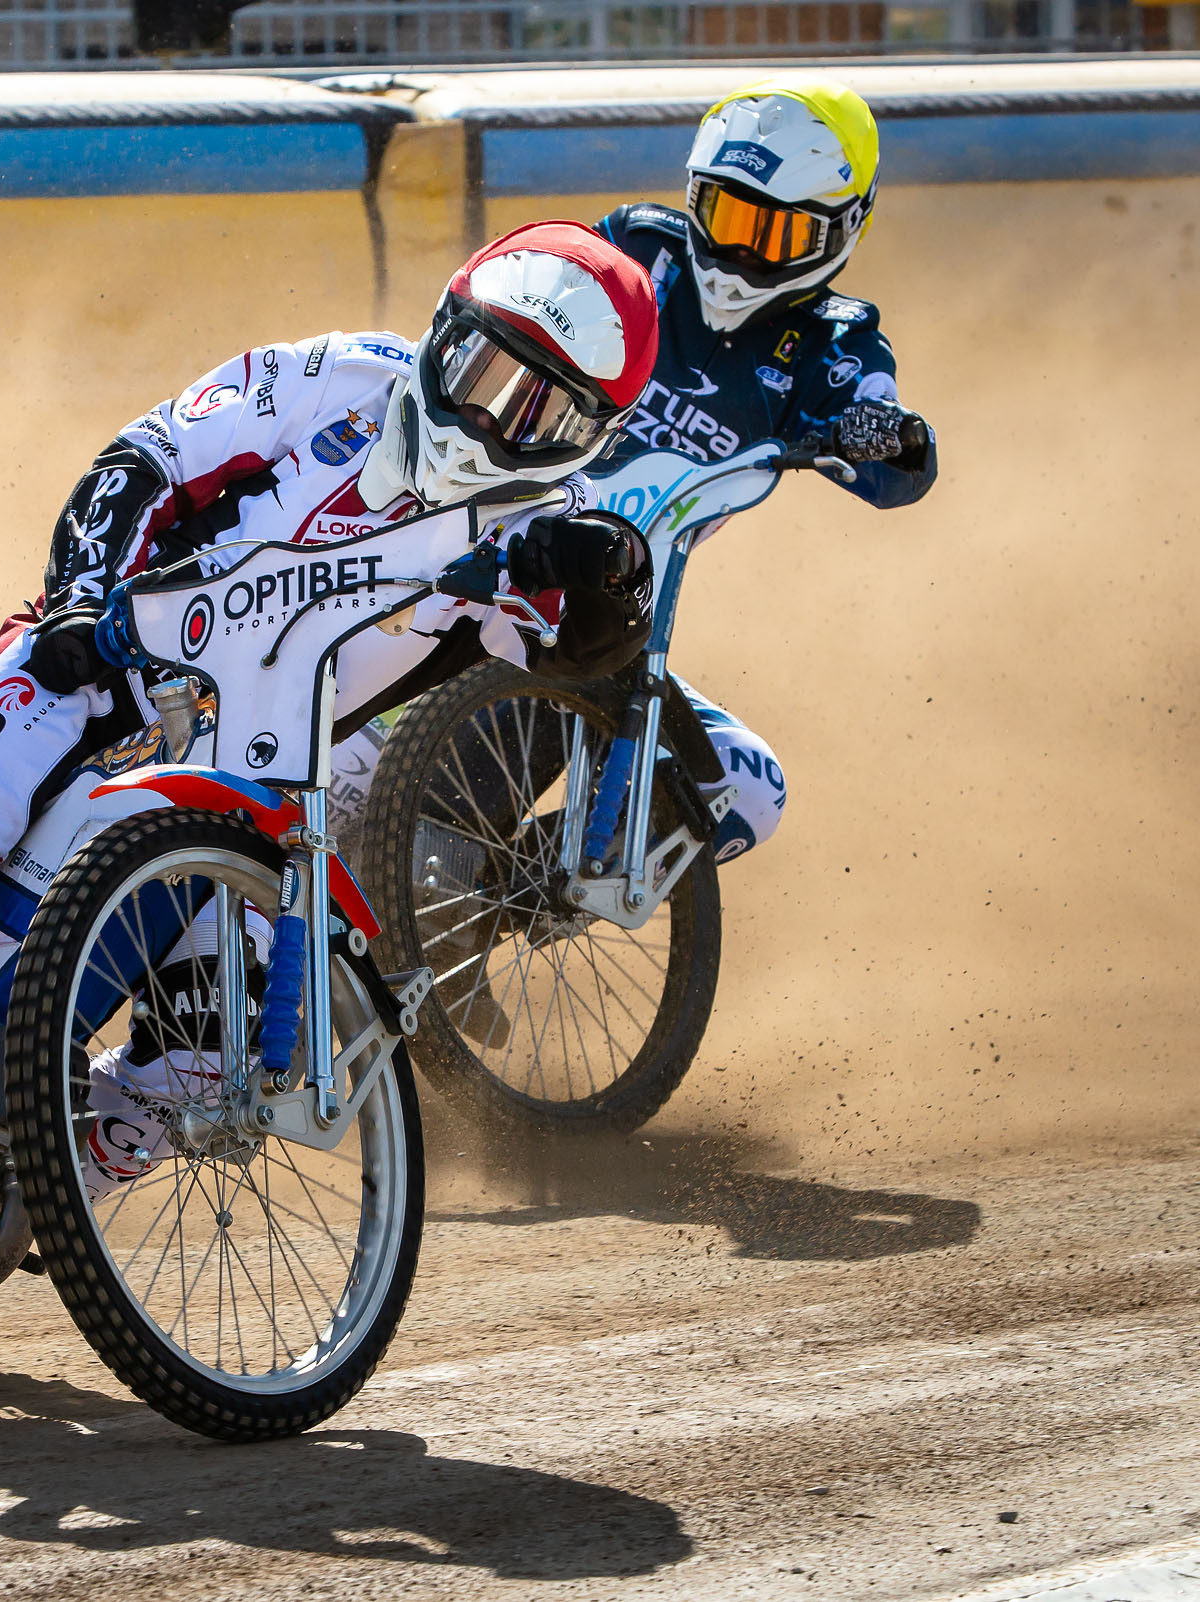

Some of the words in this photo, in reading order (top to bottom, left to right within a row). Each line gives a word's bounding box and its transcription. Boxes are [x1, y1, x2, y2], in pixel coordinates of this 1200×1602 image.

[255, 349, 279, 418] OPTIBET
[316, 520, 382, 537] LOKO
[223, 554, 383, 621] OPTIBET
[280, 865, 295, 909] HAGON
